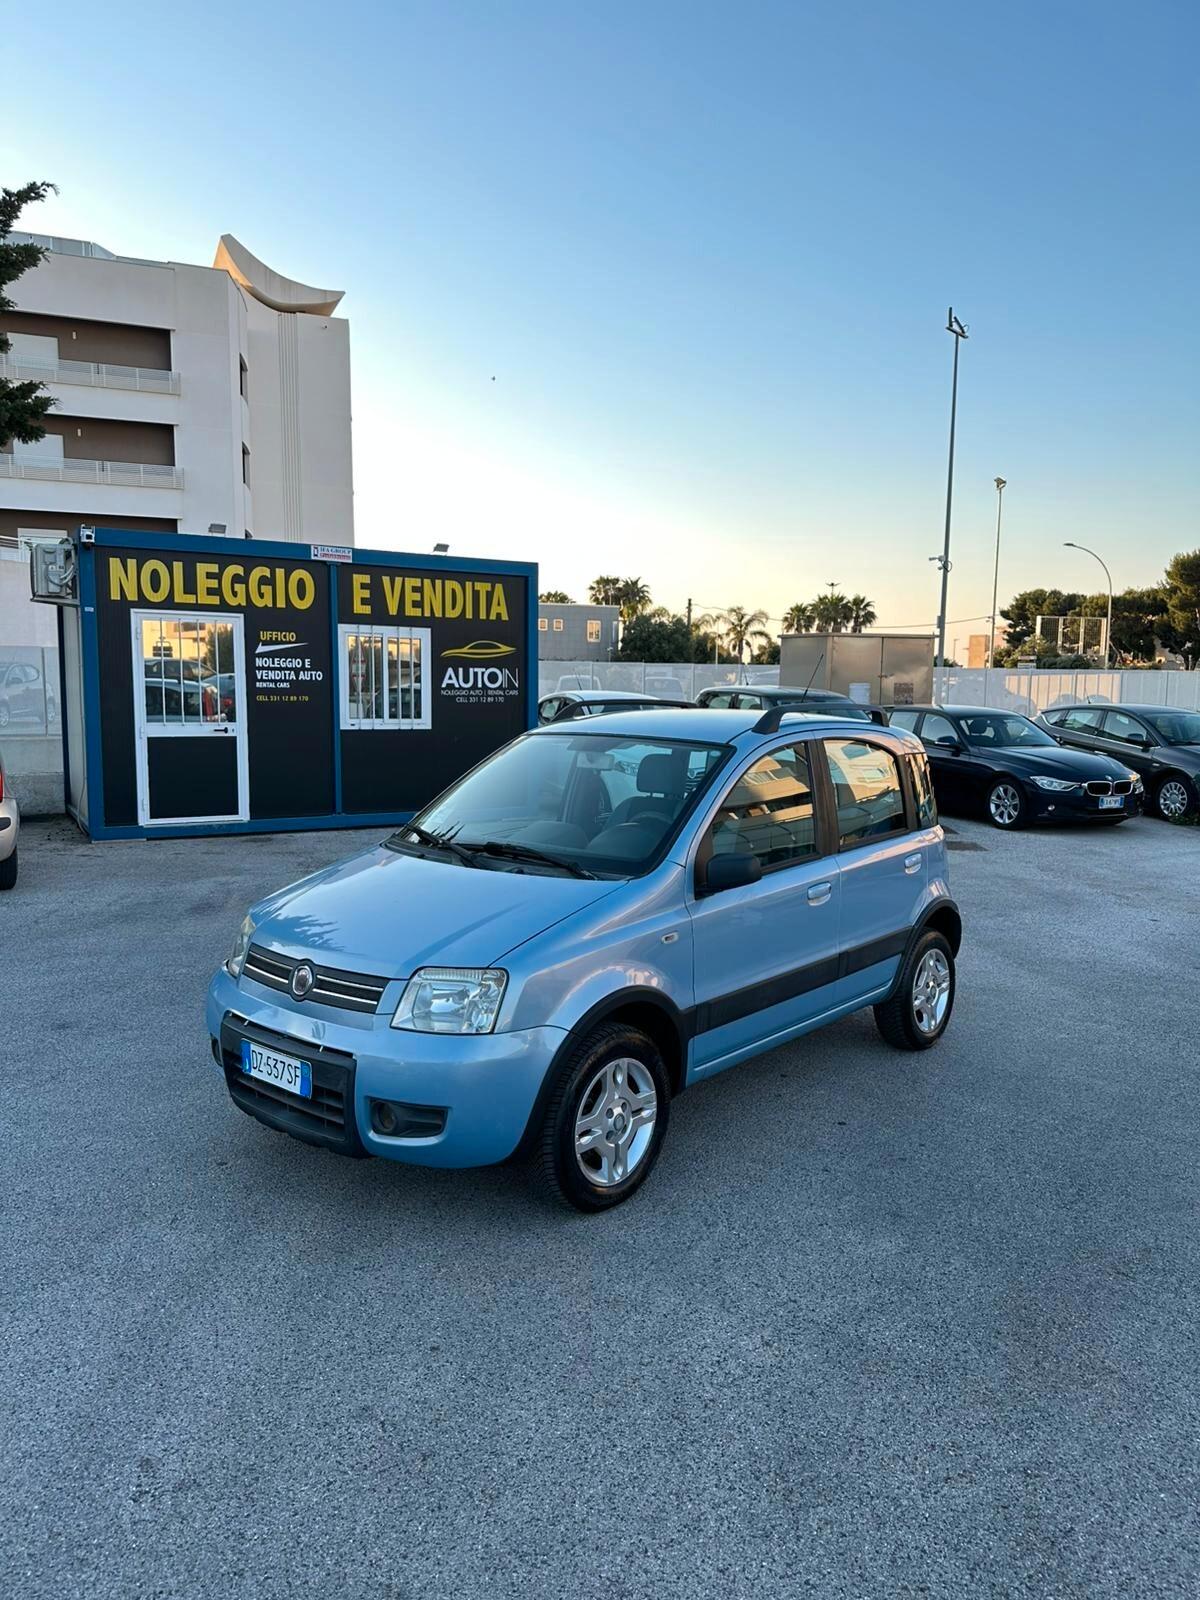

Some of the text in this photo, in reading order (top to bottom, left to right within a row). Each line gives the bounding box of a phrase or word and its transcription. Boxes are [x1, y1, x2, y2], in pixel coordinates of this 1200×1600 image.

[109, 557, 509, 621] NOLEGGIO E VENDITA
[260, 630, 296, 642] UFFICIO
[255, 657, 311, 668] NOLEGGIO E
[255, 670, 323, 681] VENDITA AUTO
[441, 666, 519, 689] AUTOIN
